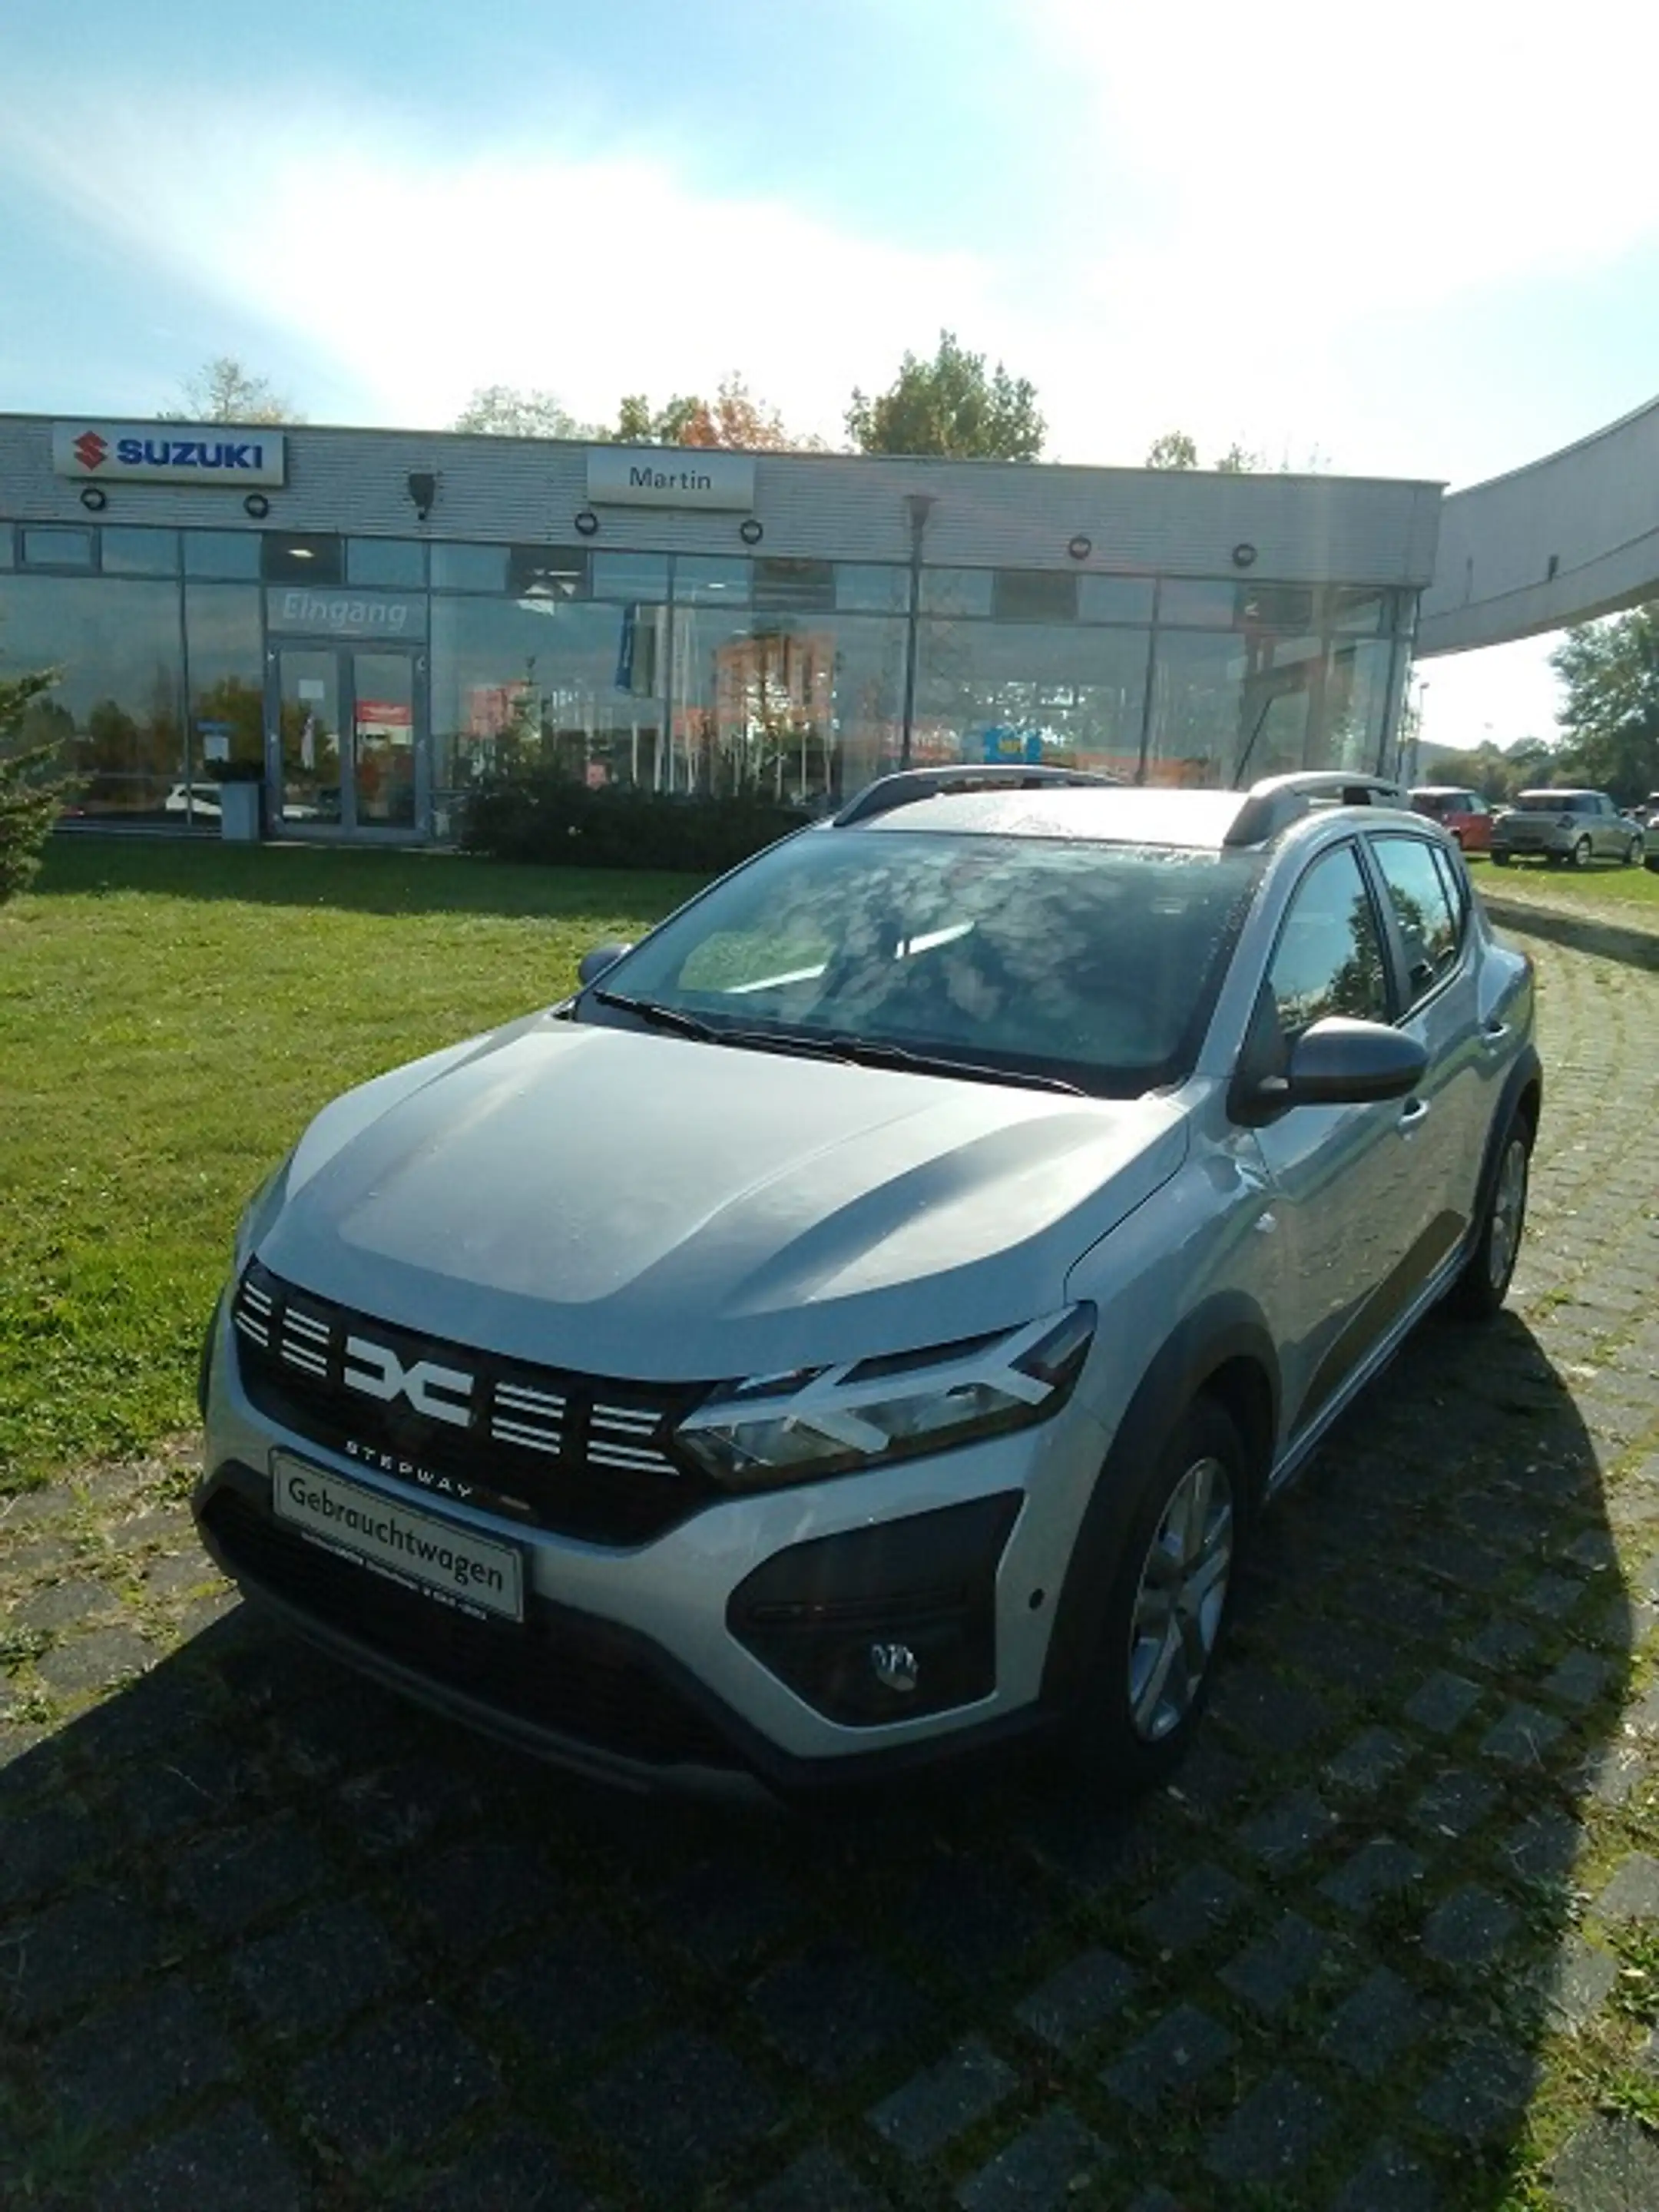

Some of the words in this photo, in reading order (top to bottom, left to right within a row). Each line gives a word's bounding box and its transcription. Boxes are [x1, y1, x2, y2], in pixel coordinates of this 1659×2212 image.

[117, 439, 263, 470] SUZUKI
[630, 466, 711, 489] Martin
[283, 593, 407, 632] Eingang
[346, 1440, 474, 1498] STEPWAY
[288, 1477, 503, 1591] Gebrauchtwagen
